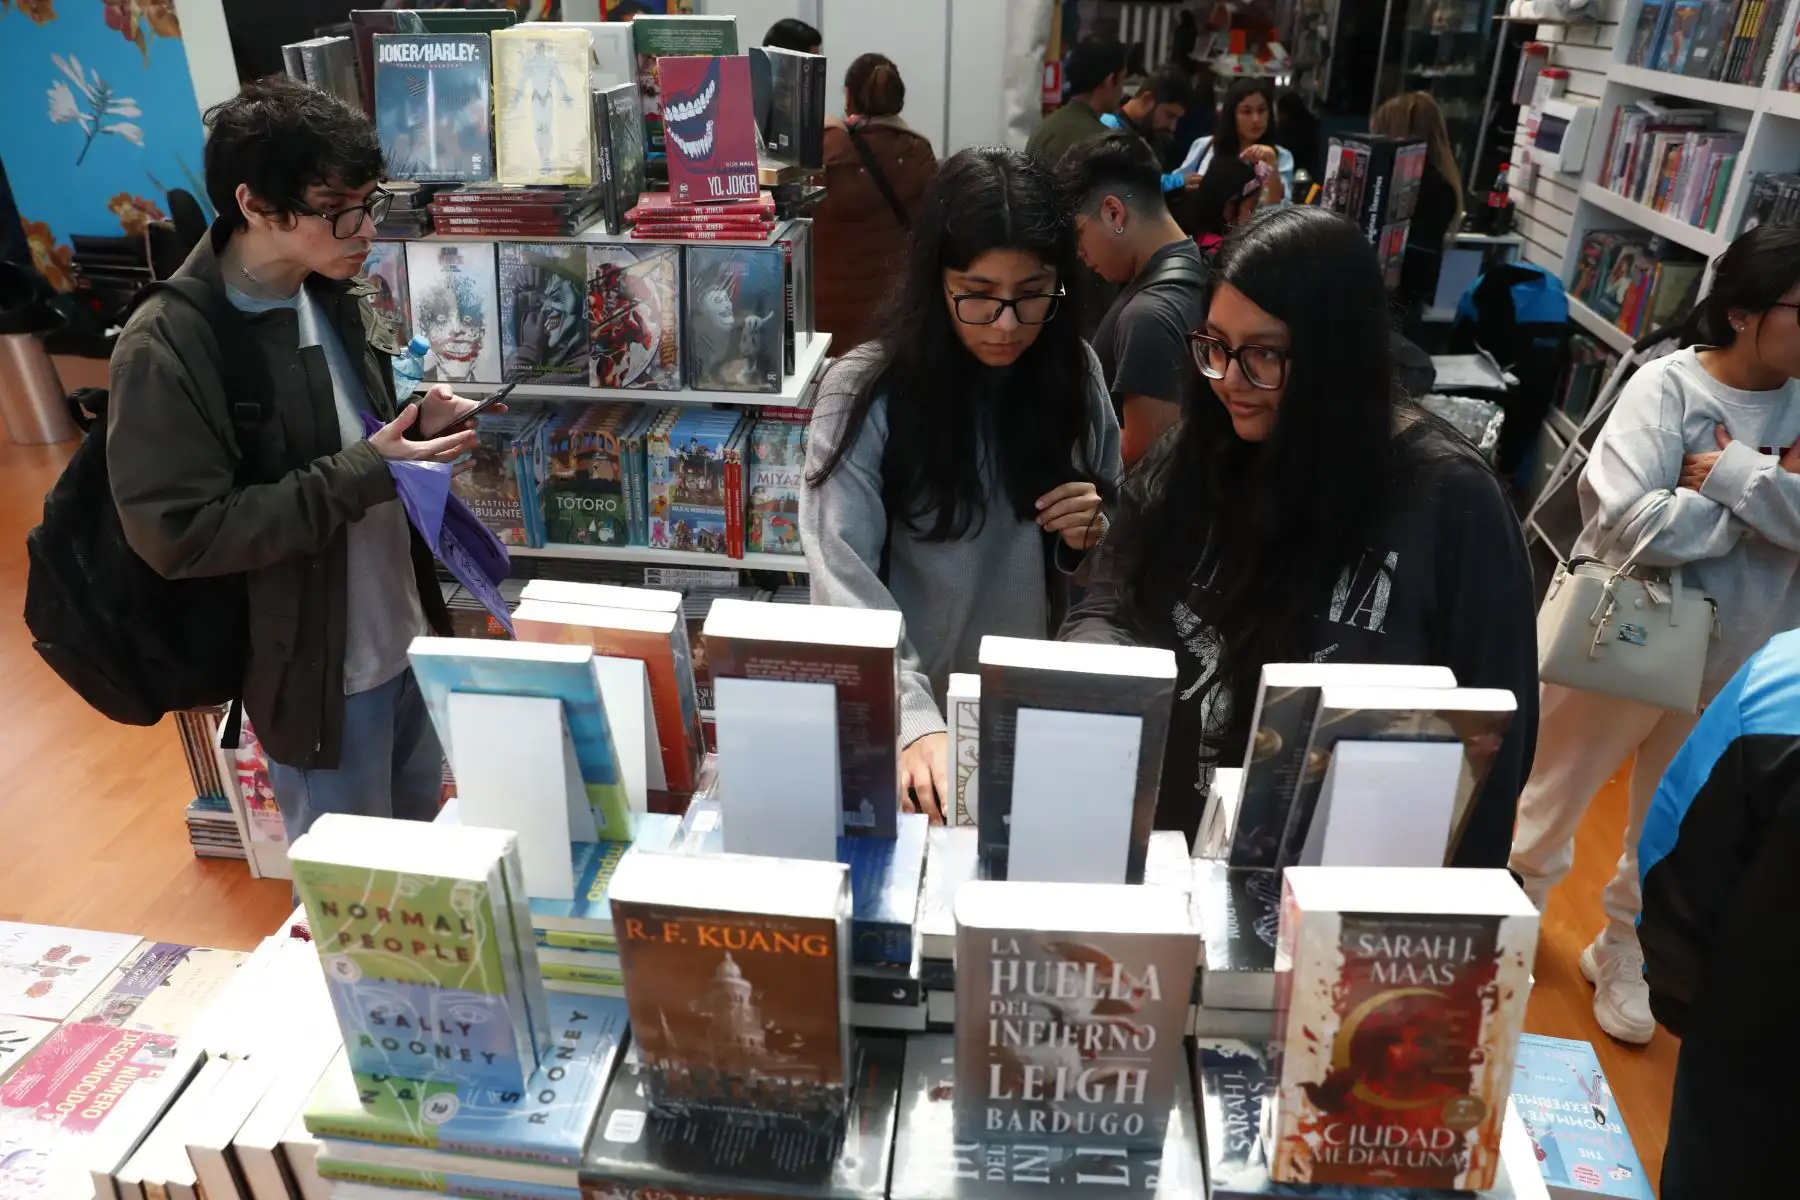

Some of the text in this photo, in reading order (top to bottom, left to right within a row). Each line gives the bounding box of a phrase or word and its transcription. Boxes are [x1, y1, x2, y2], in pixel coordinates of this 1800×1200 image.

[379, 42, 480, 62] JOKER/HARLEY:
[707, 174, 758, 196] YO, JOKER
[470, 508, 523, 519] BULANTE
[474, 500, 519, 509] CASTILLO
[556, 496, 617, 513] TOTORO
[320, 901, 475, 935] NORMAL
[338, 931, 471, 964] PEOPLE
[625, 918, 655, 940] R.
[663, 921, 688, 944] F.
[697, 925, 830, 957] KUANG
[990, 937, 1020, 955] LA
[1357, 934, 1476, 964] SARAH J.
[989, 959, 1162, 1001] HUELLA
[1370, 961, 1455, 986] MAAS
[989, 1000, 1034, 1017] DEL
[369, 1010, 472, 1036] SALLY
[988, 1019, 1157, 1051] INFIERNO
[359, 1036, 497, 1064] ROONEY
[55, 1030, 141, 1114] DESCONOCIDO
[528, 1009, 589, 1126] ROONEY
[987, 1063, 1150, 1105] LEIGH
[1514, 1092, 1596, 1115] EXPERIME
[985, 1108, 1145, 1136] BARDUGO
[1223, 1084, 1252, 1152] SARAH
[1528, 1109, 1623, 1134] ROOMMATE
[1323, 1122, 1456, 1149] CIUDAD
[1312, 1147, 1466, 1171] MEDIALUNA
[1578, 1147, 1605, 1161] THE
